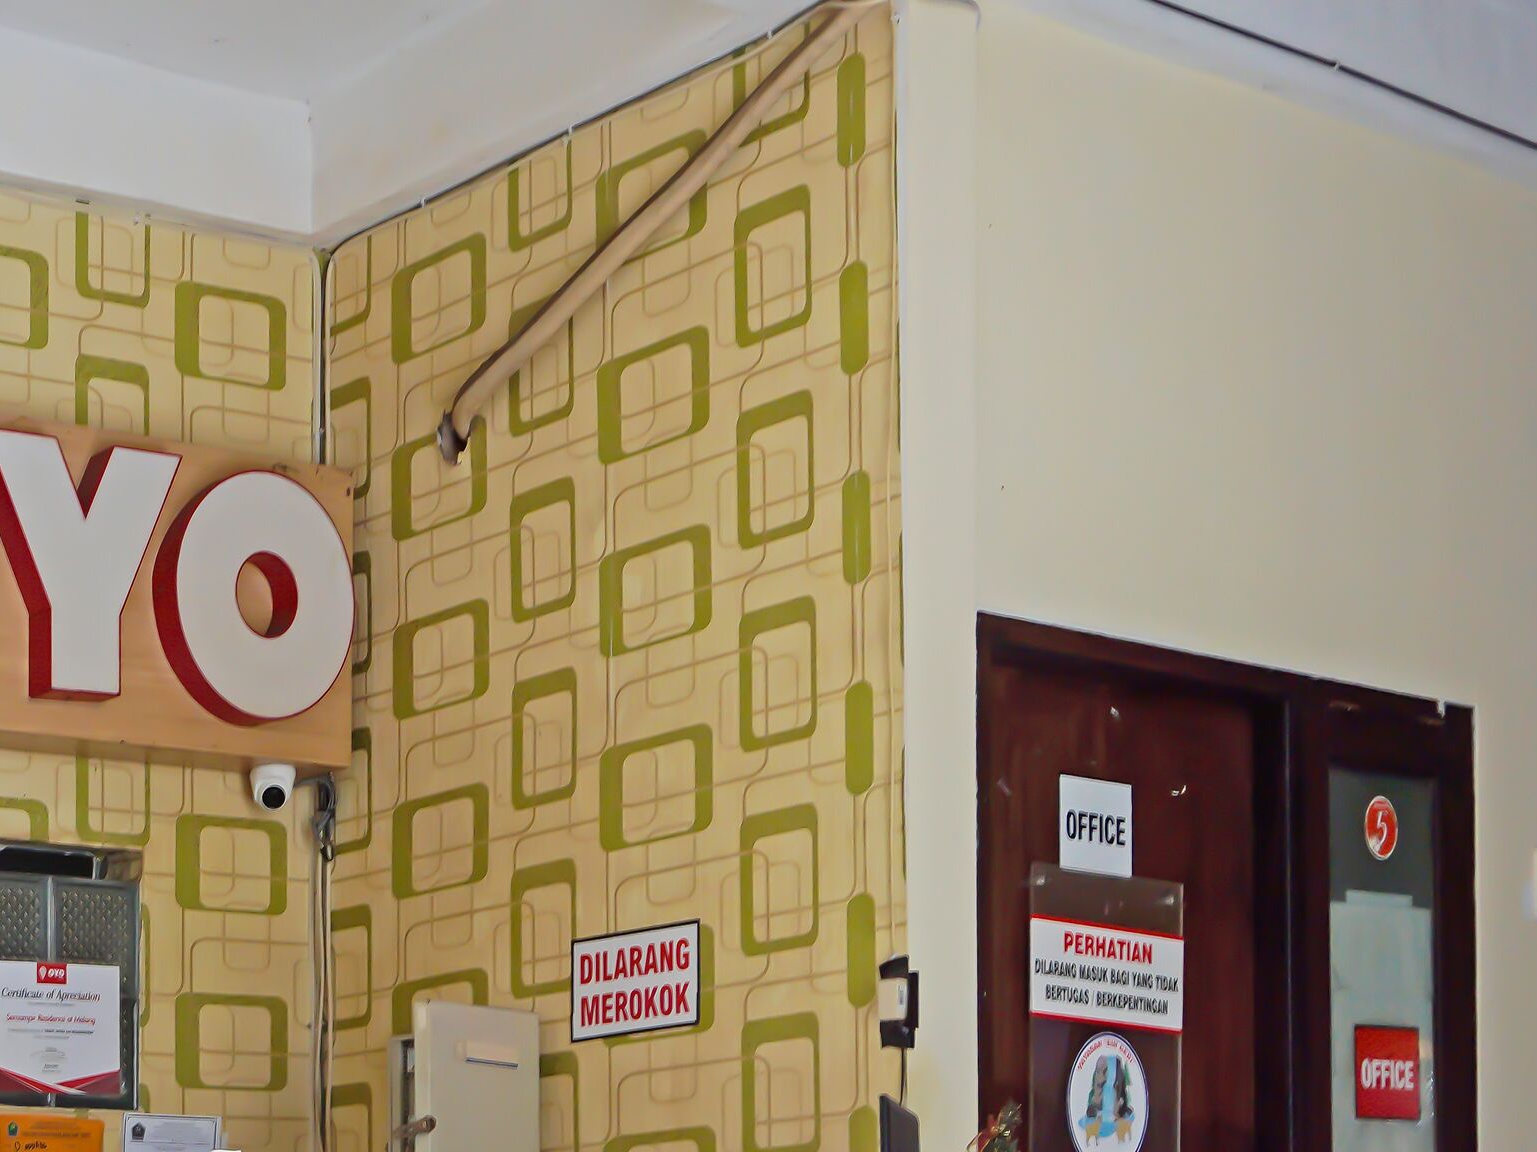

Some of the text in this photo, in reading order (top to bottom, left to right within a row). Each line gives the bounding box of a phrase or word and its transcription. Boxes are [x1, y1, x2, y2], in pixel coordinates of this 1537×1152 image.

[1066, 809, 1126, 847] OFFICE
[580, 938, 690, 985] DILARANG
[1064, 931, 1153, 965] PERHATIAN
[1034, 957, 1179, 992] DILARANG MASUK BAGI YANG TIDAK
[1, 987, 43, 999] Certificate
[46, 988, 56, 999] of
[580, 981, 690, 1028] MEROKOK
[1045, 983, 1090, 1005] BERTUGAS
[1096, 991, 1169, 1015] BERKEPENTINGAN
[1361, 1057, 1414, 1091] OFFICE
